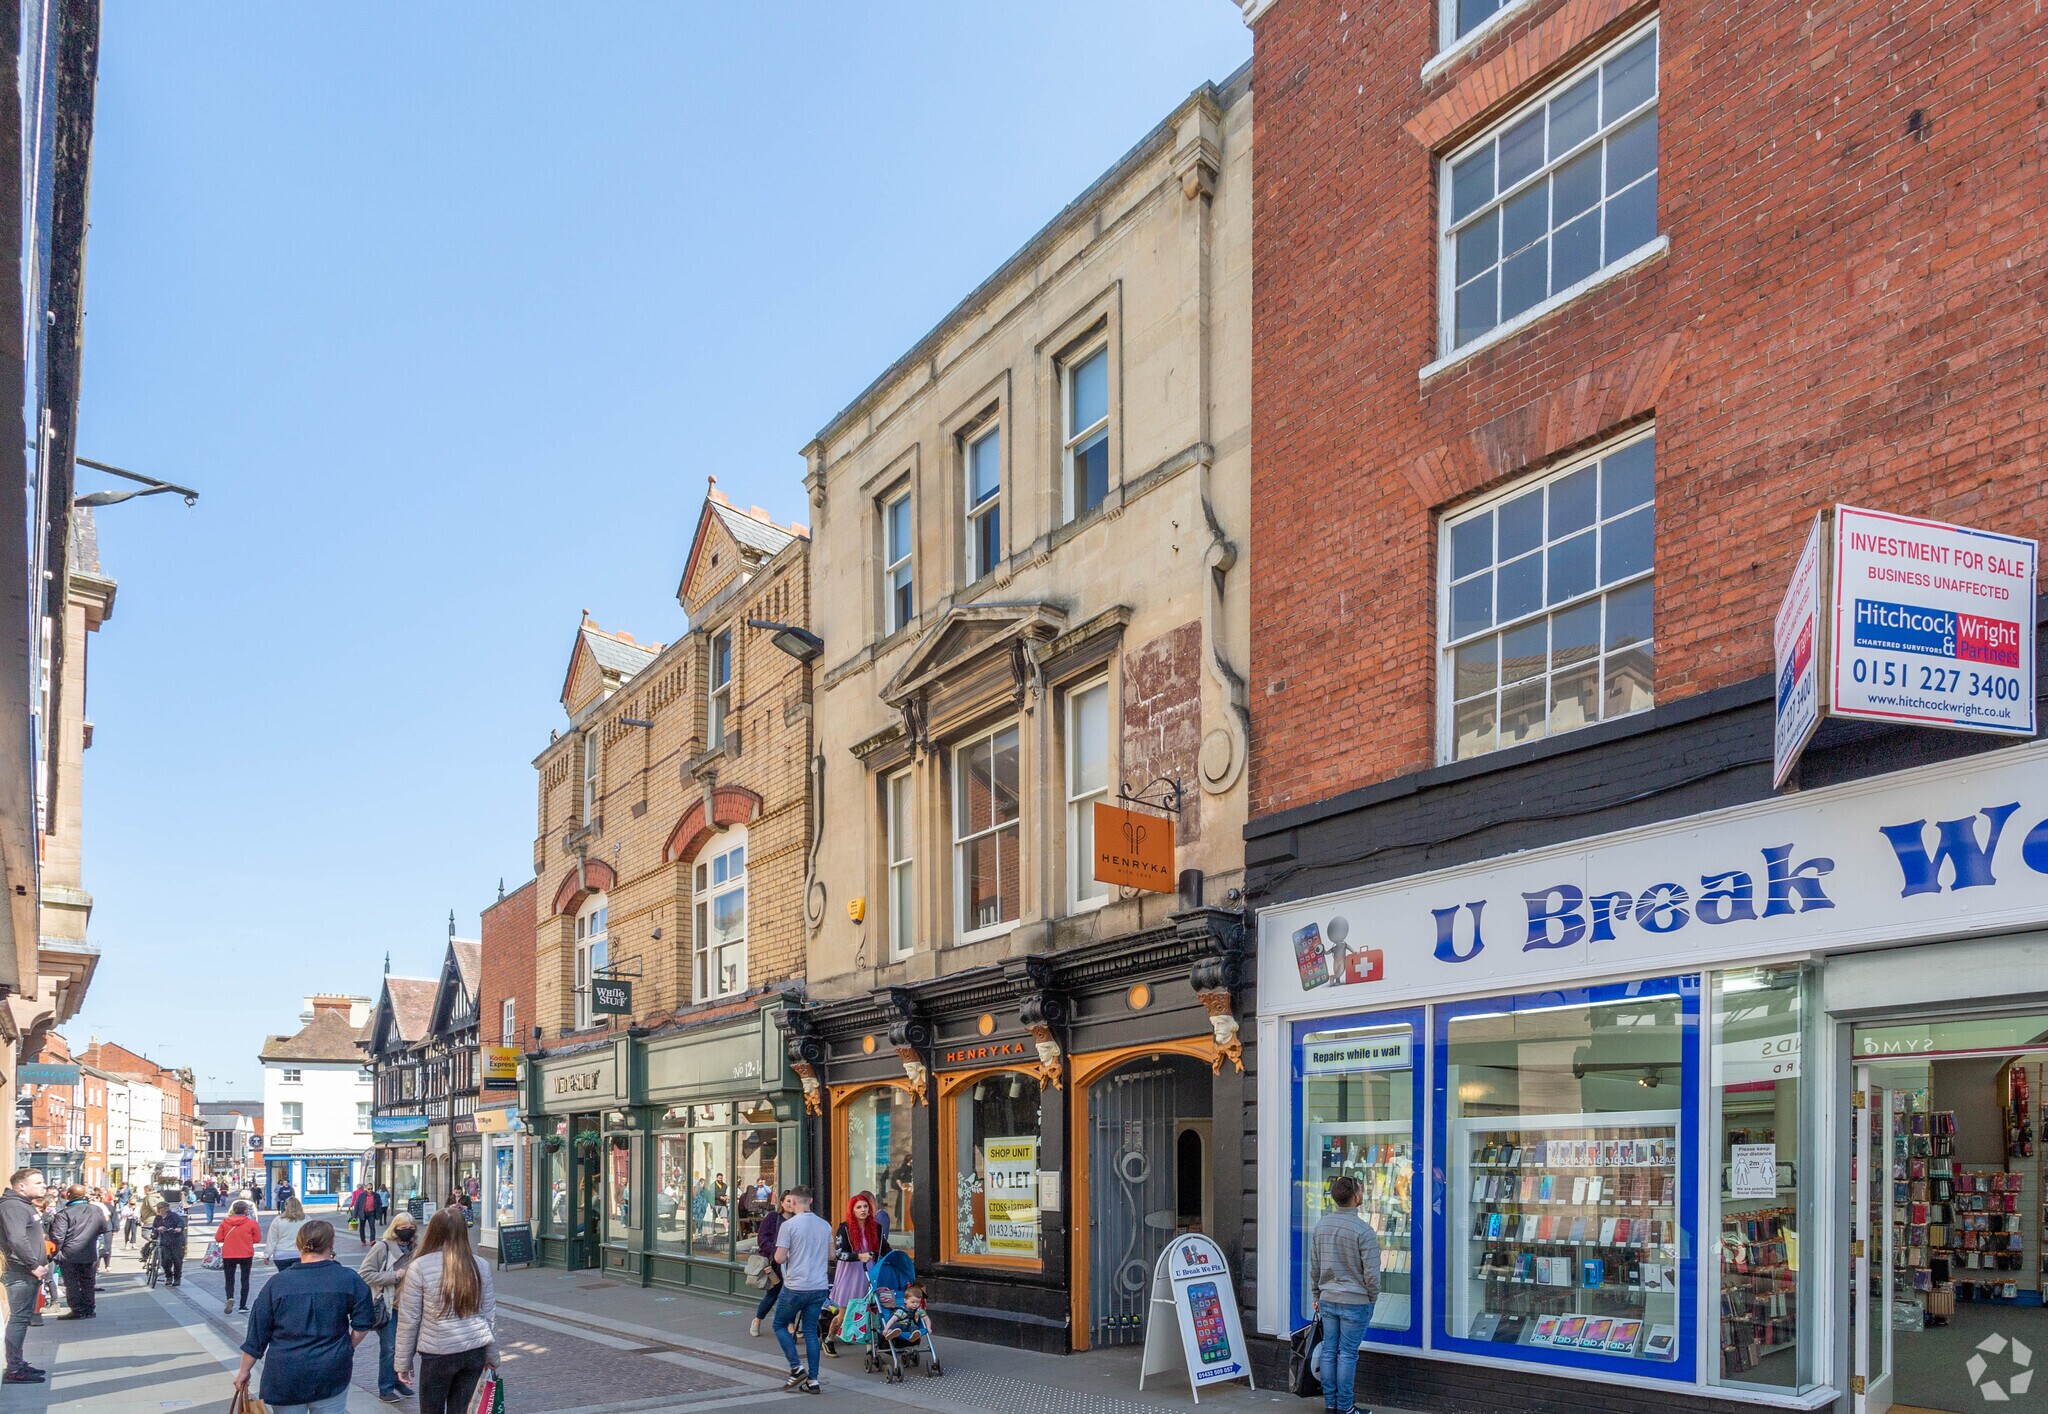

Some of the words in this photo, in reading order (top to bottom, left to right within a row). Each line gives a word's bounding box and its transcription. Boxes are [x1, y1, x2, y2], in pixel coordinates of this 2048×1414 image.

[1851, 532, 1949, 564] INVESTMENT
[1954, 550, 1983, 571] FOR
[1988, 556, 2024, 579] SALE
[1868, 566, 1930, 587] BUSINESS
[1934, 576, 2009, 600] UNAFFECTED
[1857, 602, 1955, 635] Hitchcock
[1959, 616, 2017, 647] Wright
[1857, 638, 1901, 649] CHARTERED
[1902, 643, 1943, 655] SURVEYORS
[1943, 636, 1956, 656] &
[1960, 641, 2018, 665] Partners
[1853, 658, 1907, 688] 0151
[1920, 666, 1961, 694] 227
[1969, 672, 2020, 702] 3400
[1868, 694, 2011, 718] www.hitchcockwright.co.uk
[1102, 853, 1168, 875] HENRYKA
[1431, 899, 1487, 963] U
[1521, 842, 1836, 953] Break
[947, 1042, 1024, 1062] HENRYKA
[1313, 1051, 1345, 1063] Repairs
[1347, 1048, 1370, 1060] while
[1373, 1049, 1379, 1058] u
[1381, 1045, 1401, 1057] wait
[417, 1117, 426, 1125] the
[456, 1122, 474, 1133] COUNTRY
[991, 1148, 1010, 1158] SHOP
[1012, 1147, 1030, 1157] UNIT
[1651, 1155, 1663, 1164] A12
[989, 1171, 1004, 1189] TO
[1008, 1171, 1030, 1189] LET
[989, 1224, 1008, 1237] 01432
[1009, 1224, 1034, 1238] 343777
[1183, 1268, 1200, 1276] Break
[1554, 1335, 1571, 1343] Tab
[1580, 1339, 1597, 1347] Tab
[1606, 1340, 1625, 1349] Tab
[1198, 1370, 1214, 1379] 01432
